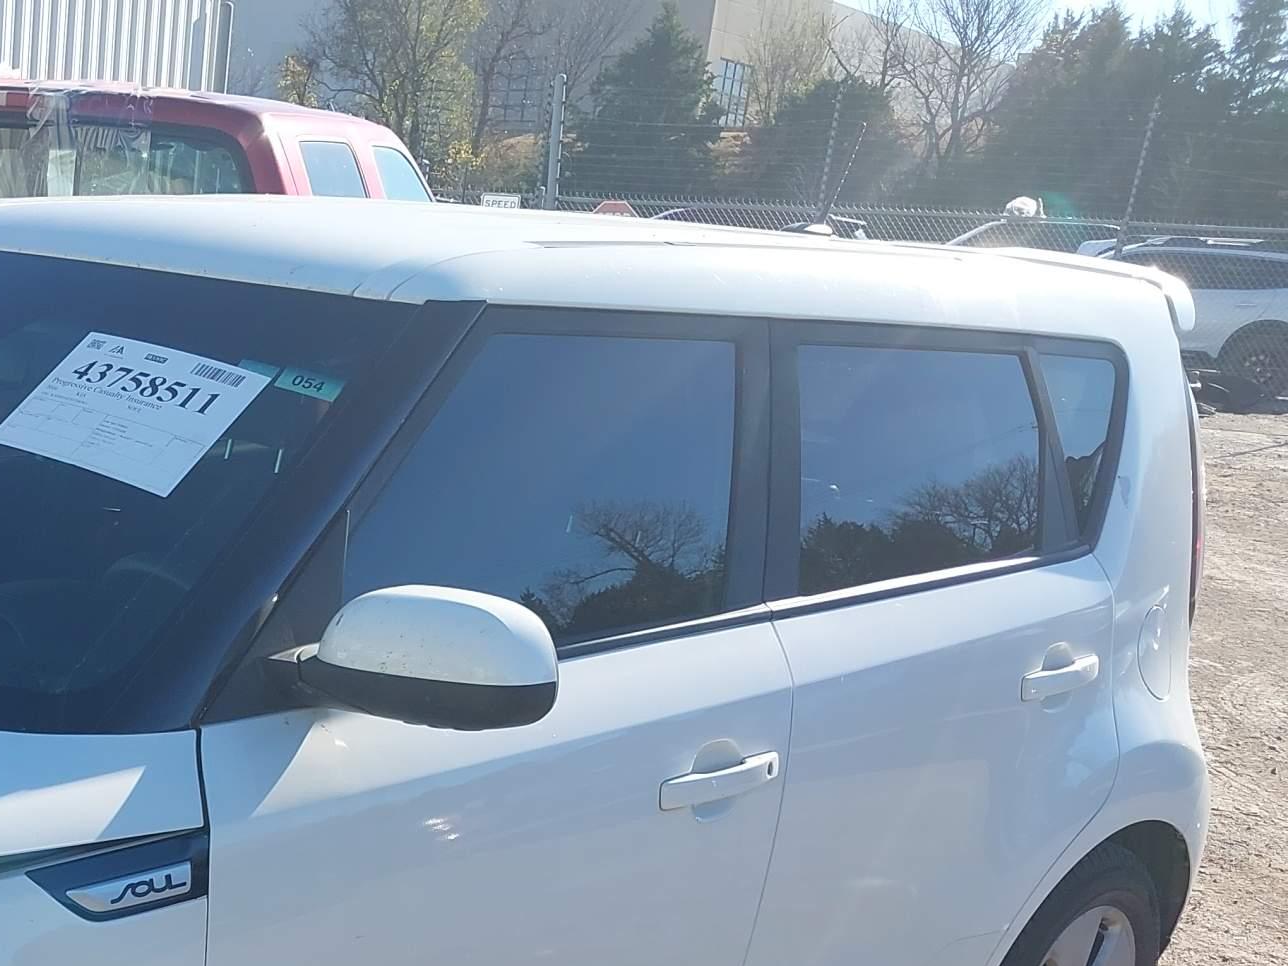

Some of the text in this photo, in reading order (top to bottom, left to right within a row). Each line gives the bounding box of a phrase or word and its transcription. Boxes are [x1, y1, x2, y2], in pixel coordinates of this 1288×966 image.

[484, 199, 516, 208] SPEED
[52, 377, 94, 393] Progressive
[93, 385, 124, 400] Casualty
[126, 394, 163, 411] Insurance
[72, 360, 221, 416] 43758511
[292, 374, 325, 393] 054
[110, 874, 187, 904] SOUL
